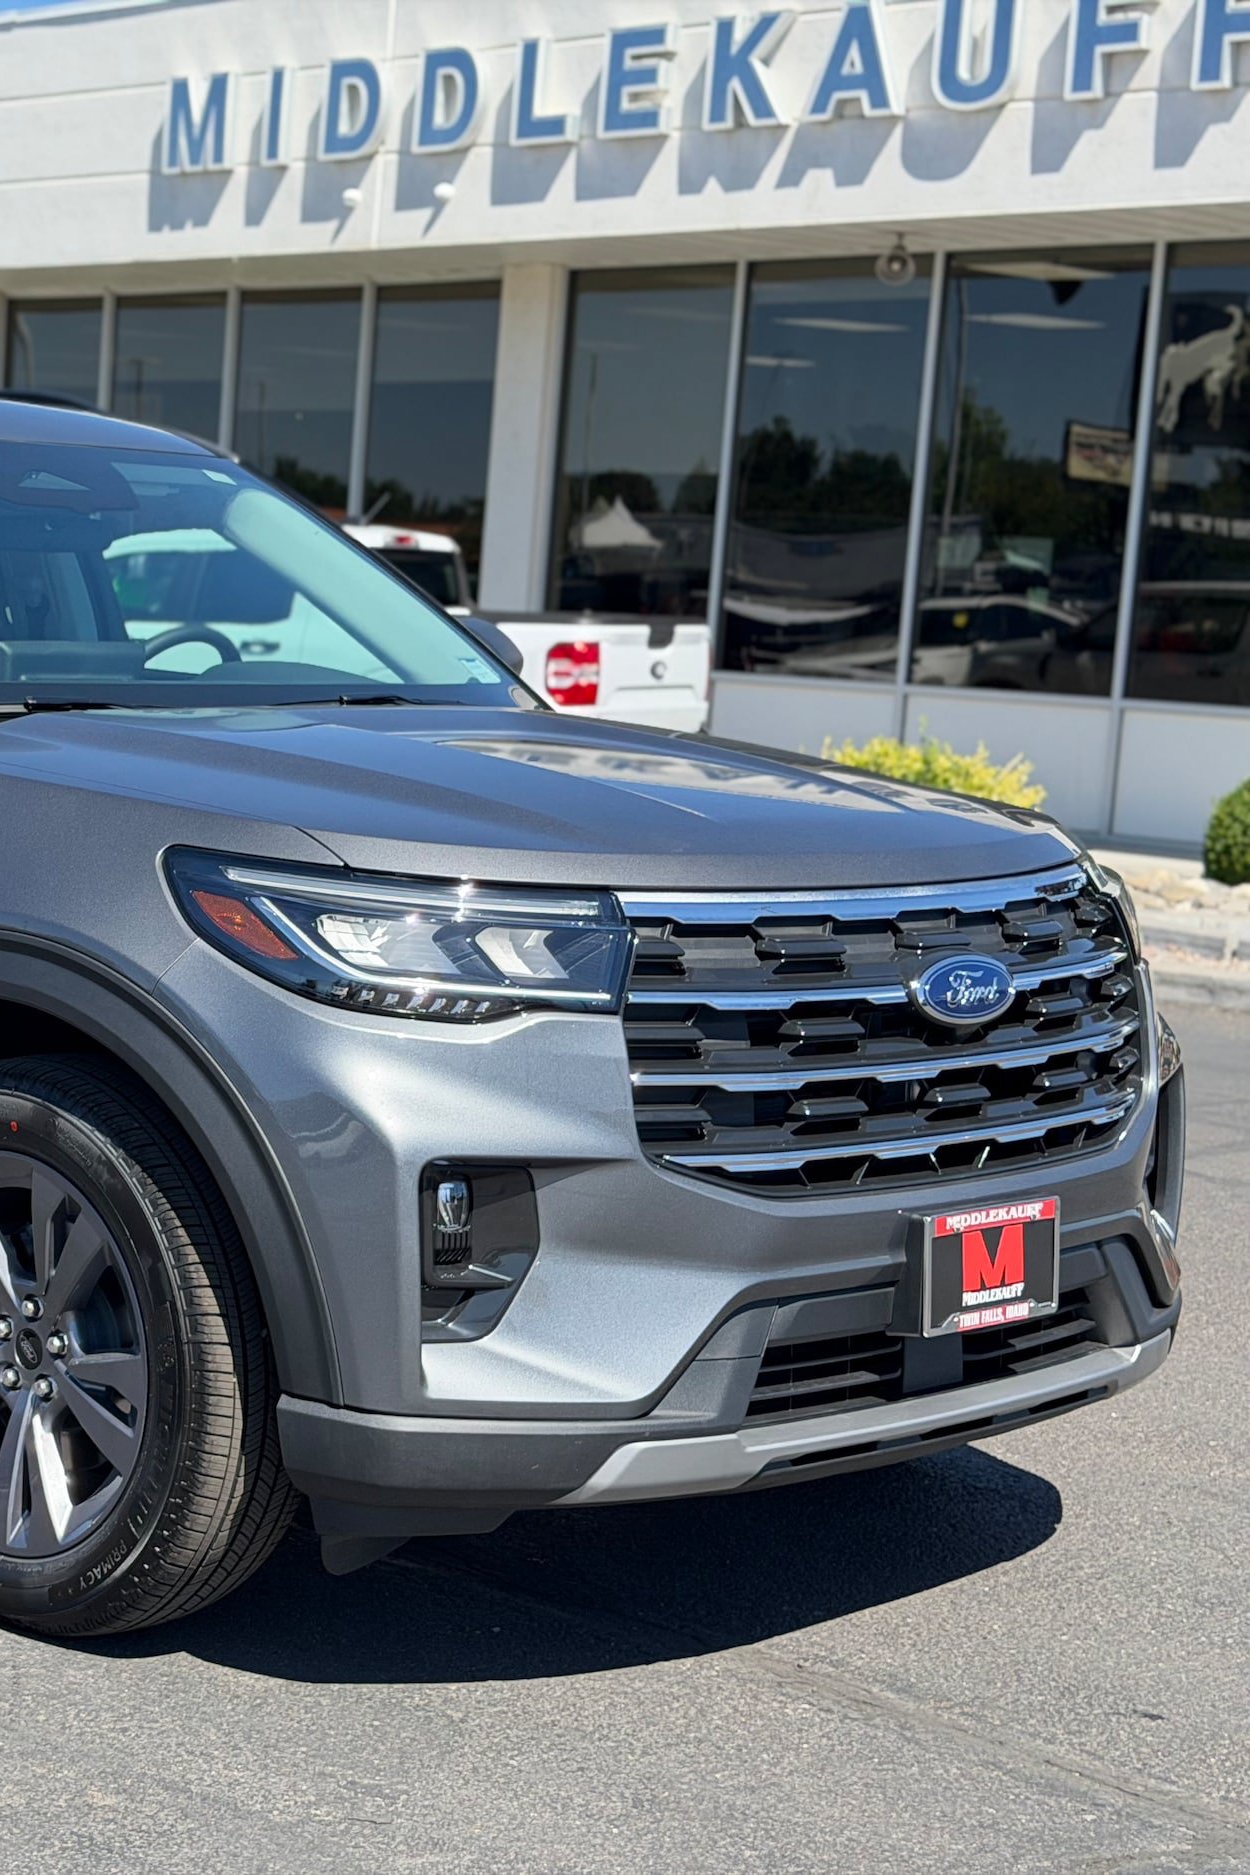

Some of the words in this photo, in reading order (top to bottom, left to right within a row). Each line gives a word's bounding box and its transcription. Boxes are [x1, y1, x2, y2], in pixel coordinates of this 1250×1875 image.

[946, 970, 1000, 1008] Ford
[946, 1202, 1044, 1230] MIDDLEKAUFF
[962, 1224, 1025, 1291] M
[962, 1282, 1025, 1307] MIDDLEKAUFF
[959, 1312, 981, 1328] TWIN
[1005, 1303, 1029, 1319] IDAHO
[79, 1538, 128, 1592] PRIMACY
